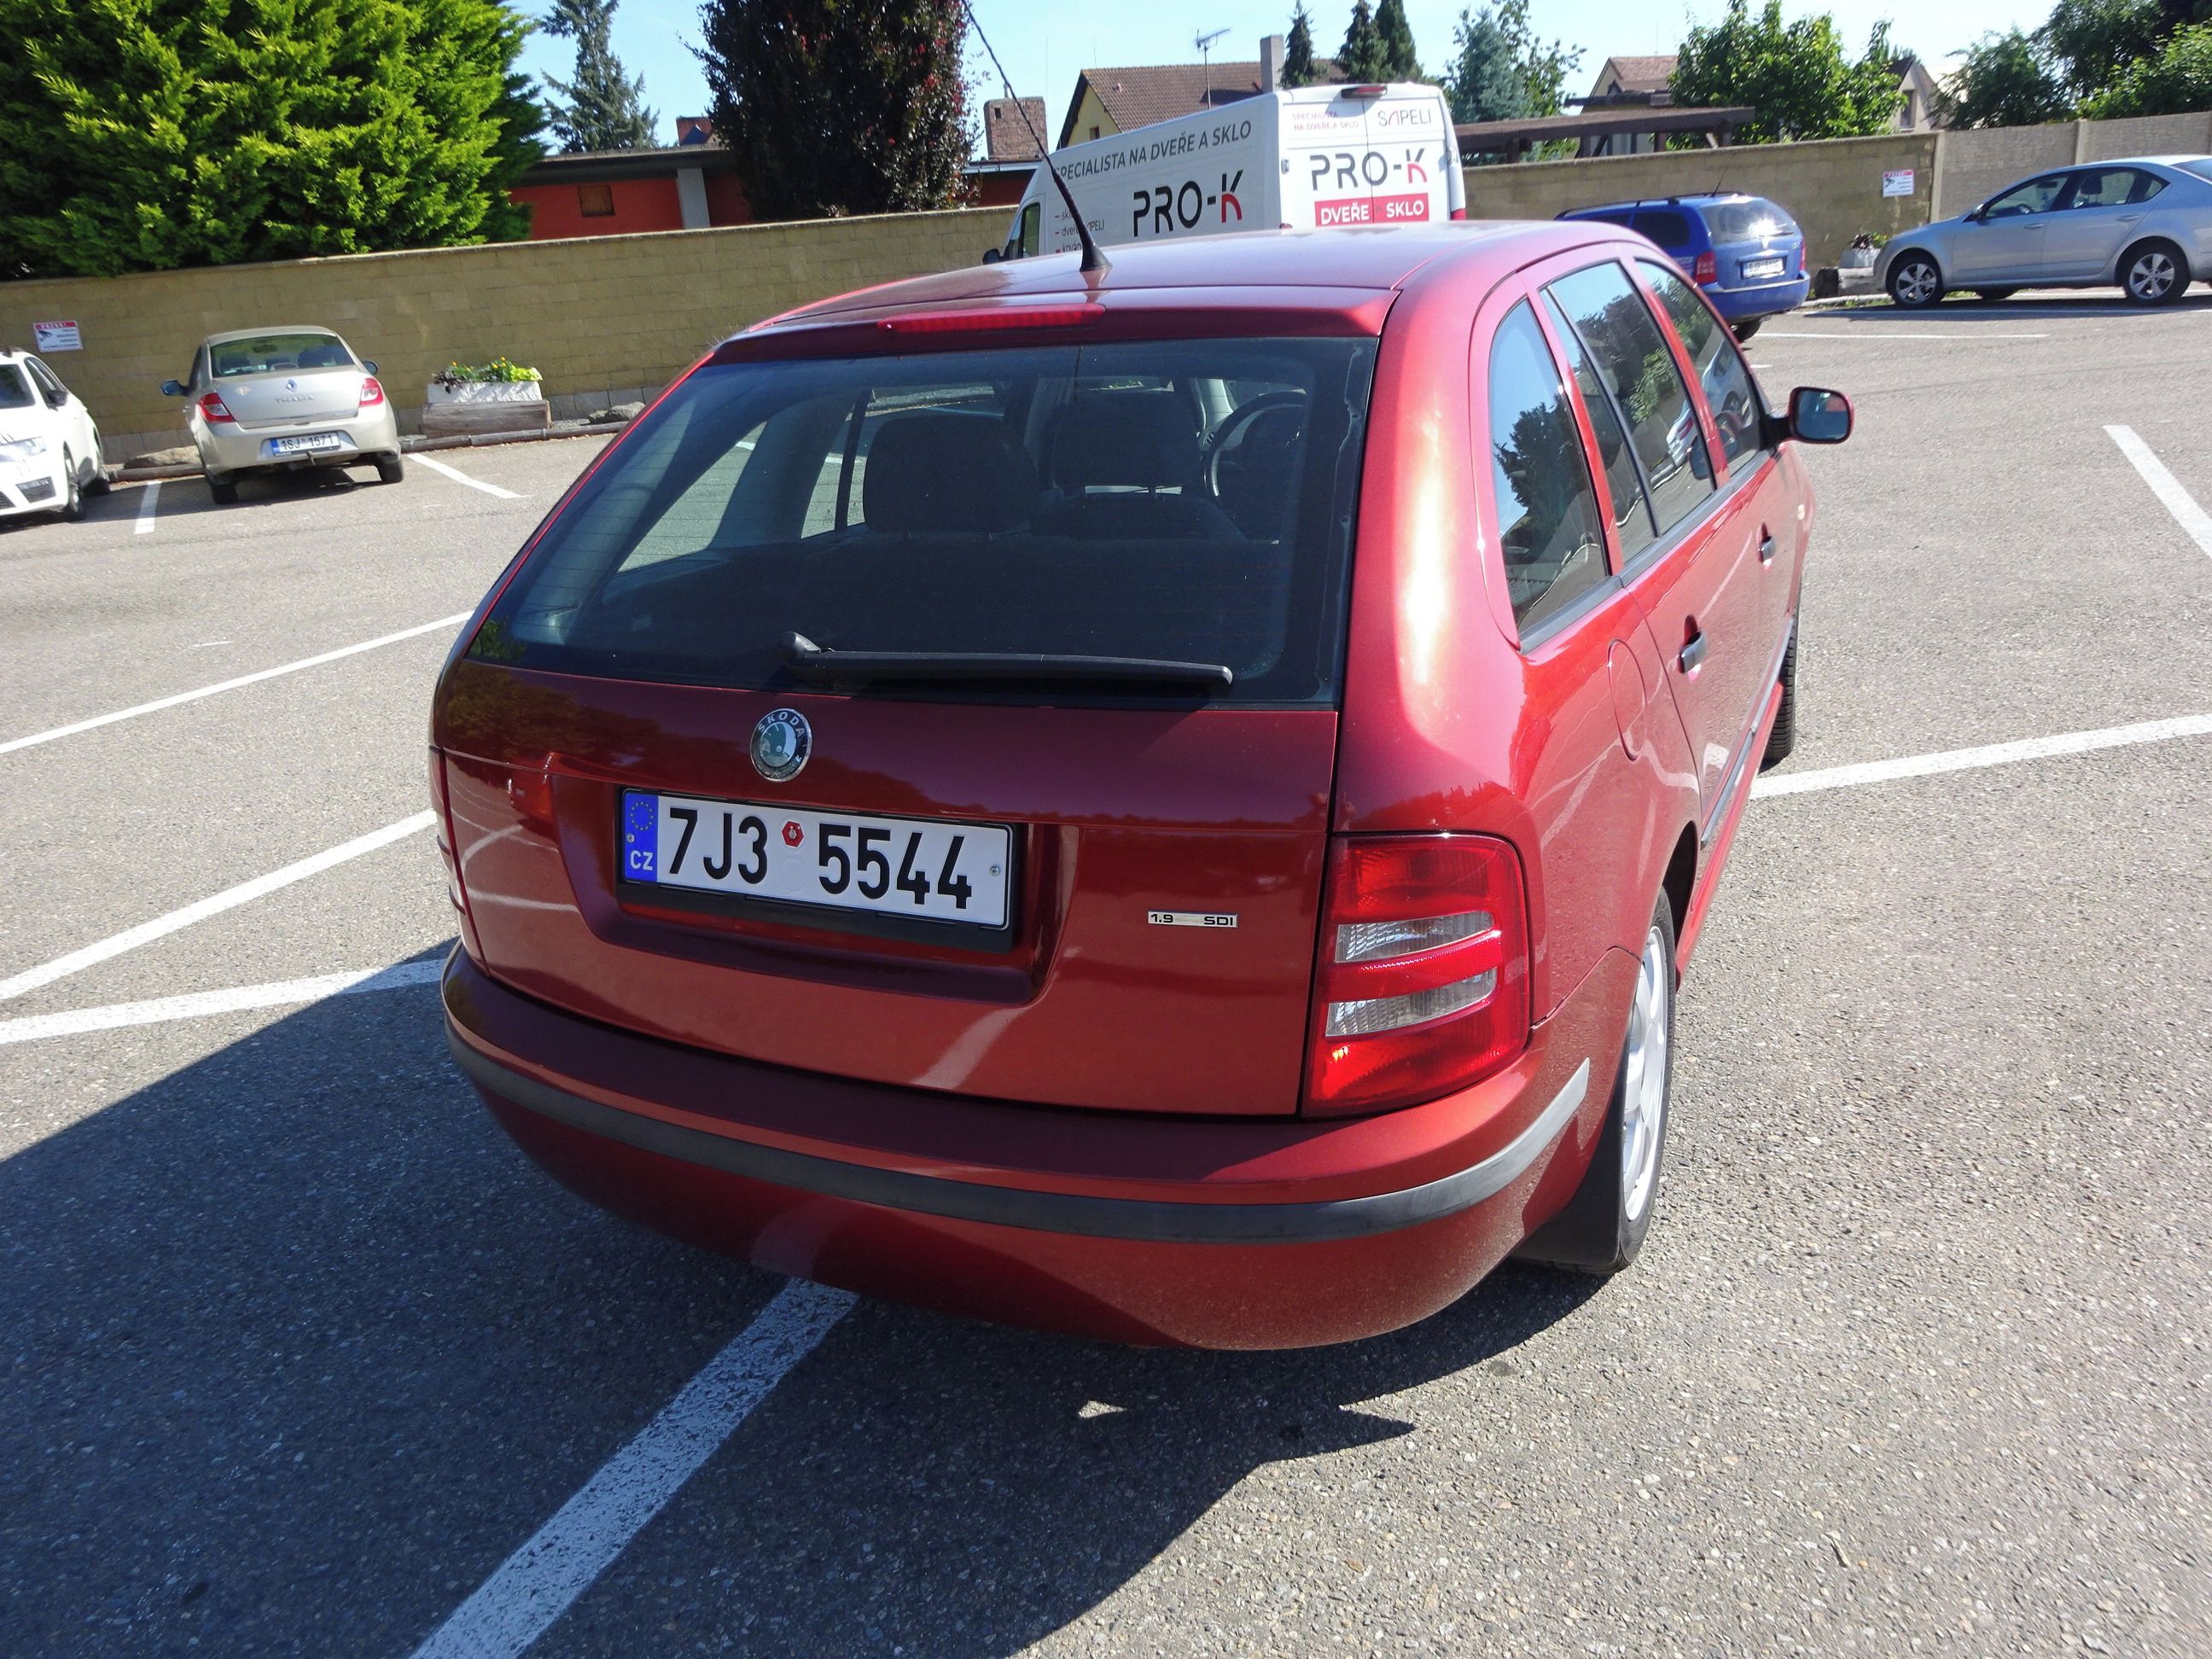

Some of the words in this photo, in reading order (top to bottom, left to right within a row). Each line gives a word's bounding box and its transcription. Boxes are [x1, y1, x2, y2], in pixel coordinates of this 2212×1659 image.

[1377, 108, 1431, 127] SAPELI
[1056, 153, 1126, 180] PECIALISTA
[1129, 146, 1147, 166] NA
[1150, 131, 1196, 160] DVEŘE
[1198, 131, 1208, 149] A
[1212, 119, 1252, 146] SKLO
[1309, 148, 1428, 191] PRO-K
[1133, 169, 1244, 237] PRO-K
[1320, 201, 1370, 225] DVEŘE
[1386, 200, 1424, 218] SKLO
[281, 439, 301, 451] 1SJ
[308, 434, 334, 447] 1571
[630, 850, 654, 871] CZ
[669, 807, 768, 884] 7J3
[818, 824, 972, 910] 5544
[1150, 913, 1173, 923] 1.9
[1203, 916, 1233, 926] SDI
